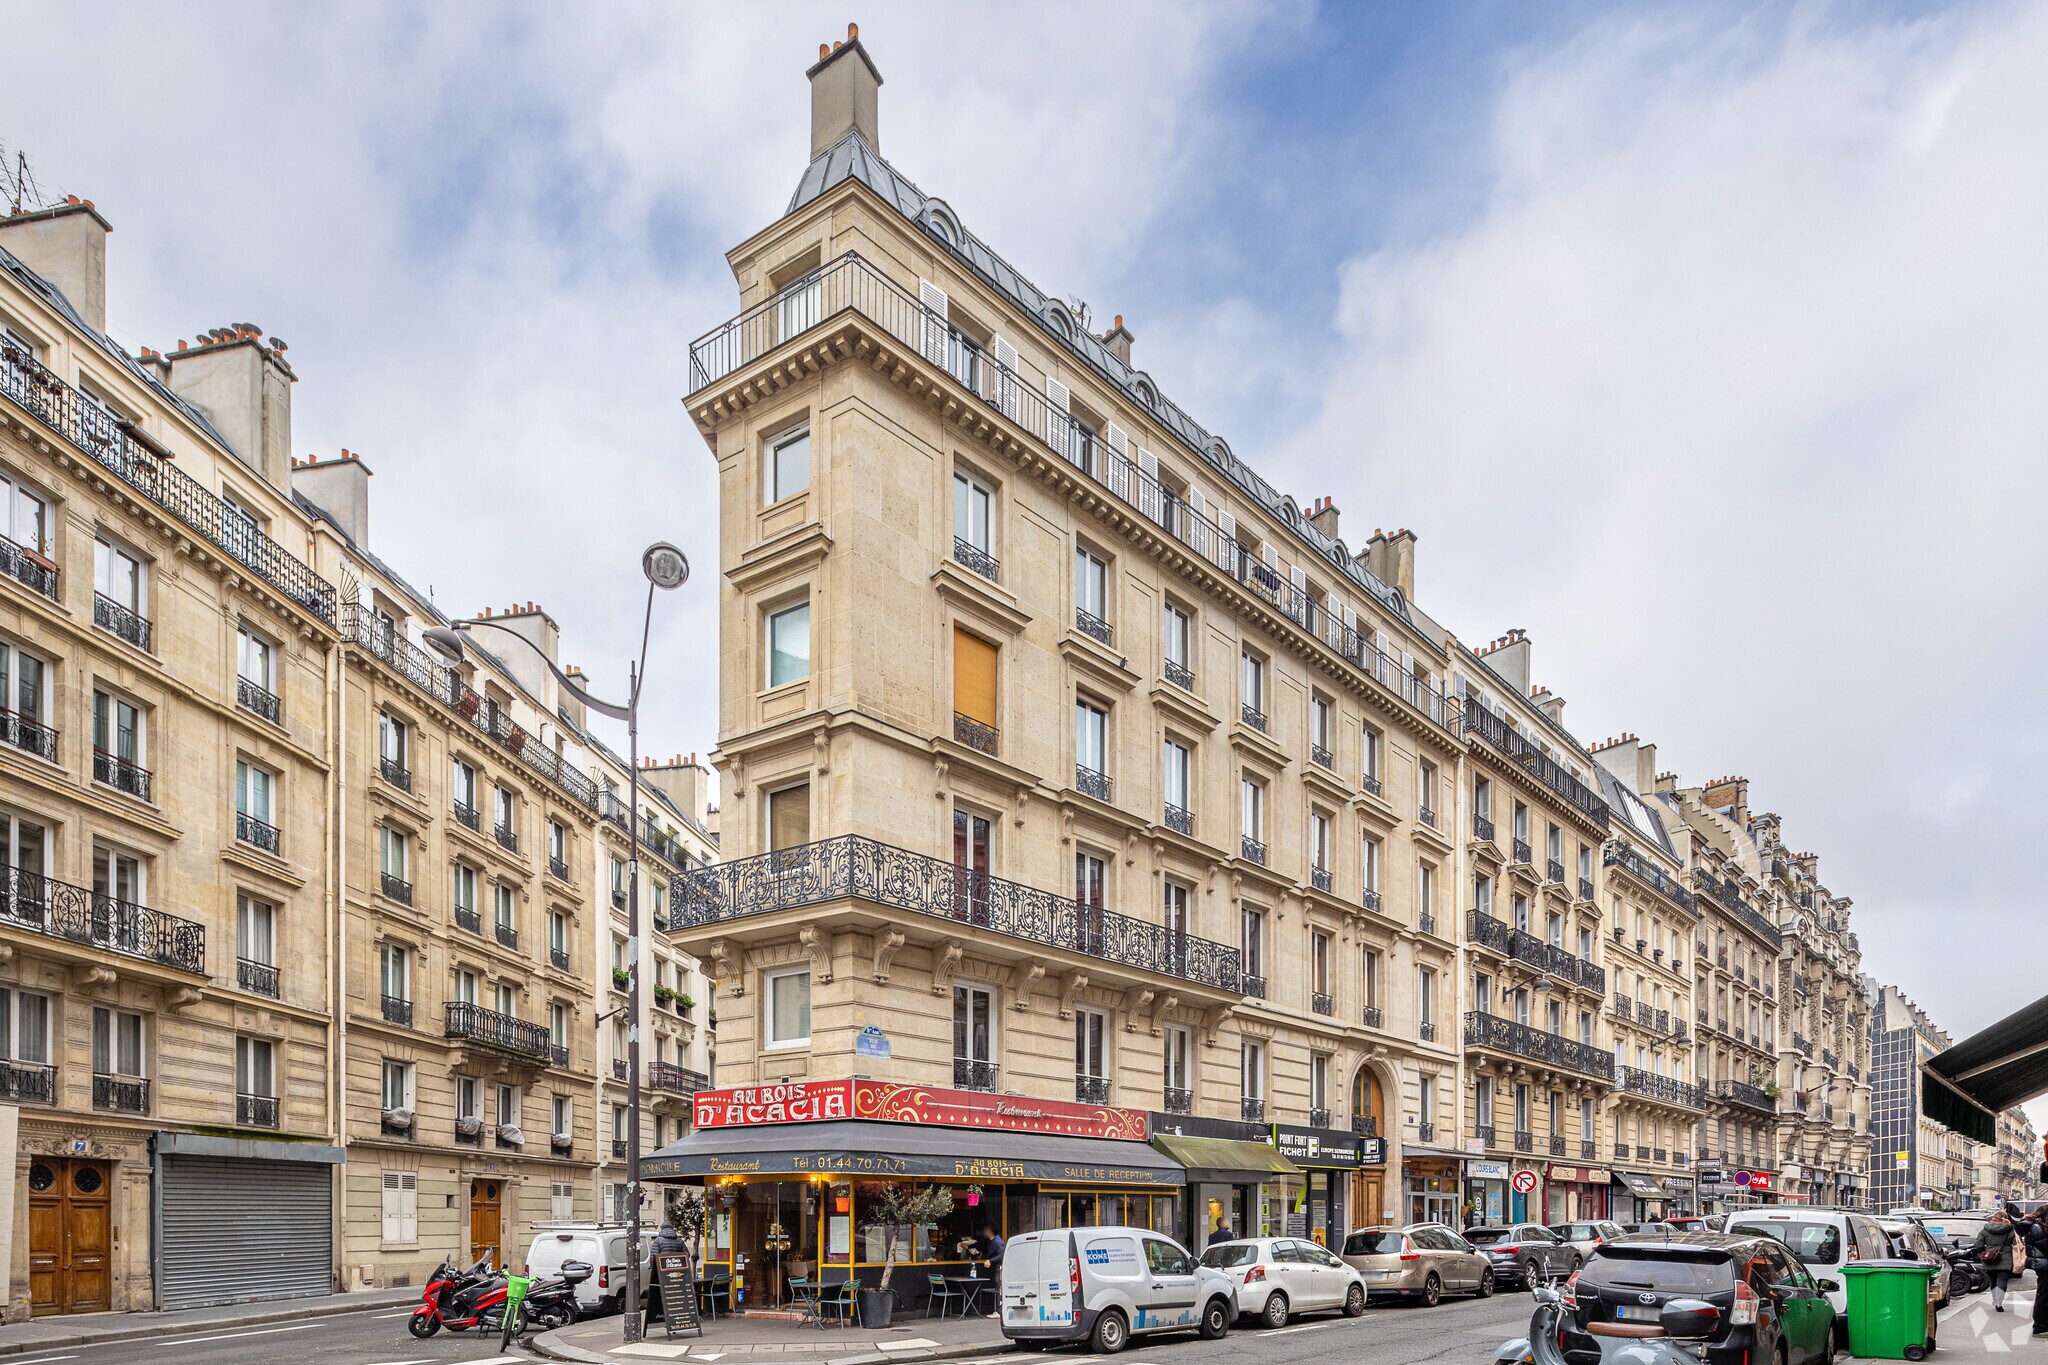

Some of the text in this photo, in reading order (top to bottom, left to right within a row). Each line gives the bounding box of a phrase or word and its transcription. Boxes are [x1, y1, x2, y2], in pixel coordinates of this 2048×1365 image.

[733, 1084, 806, 1104] AU BOIS
[696, 1094, 847, 1126] D'ACACIA
[1279, 1133, 1307, 1146] POINT FORT
[709, 1157, 760, 1171] Restaurant
[818, 1157, 906, 1171] 01.44.70.71.71
[973, 1159, 1008, 1168] AU BOIS
[955, 1164, 1025, 1177] D'ACACIA
[1064, 1167, 1153, 1180] SALLE DE RECEPTION
[1665, 1177, 1693, 1188] PRESSING
